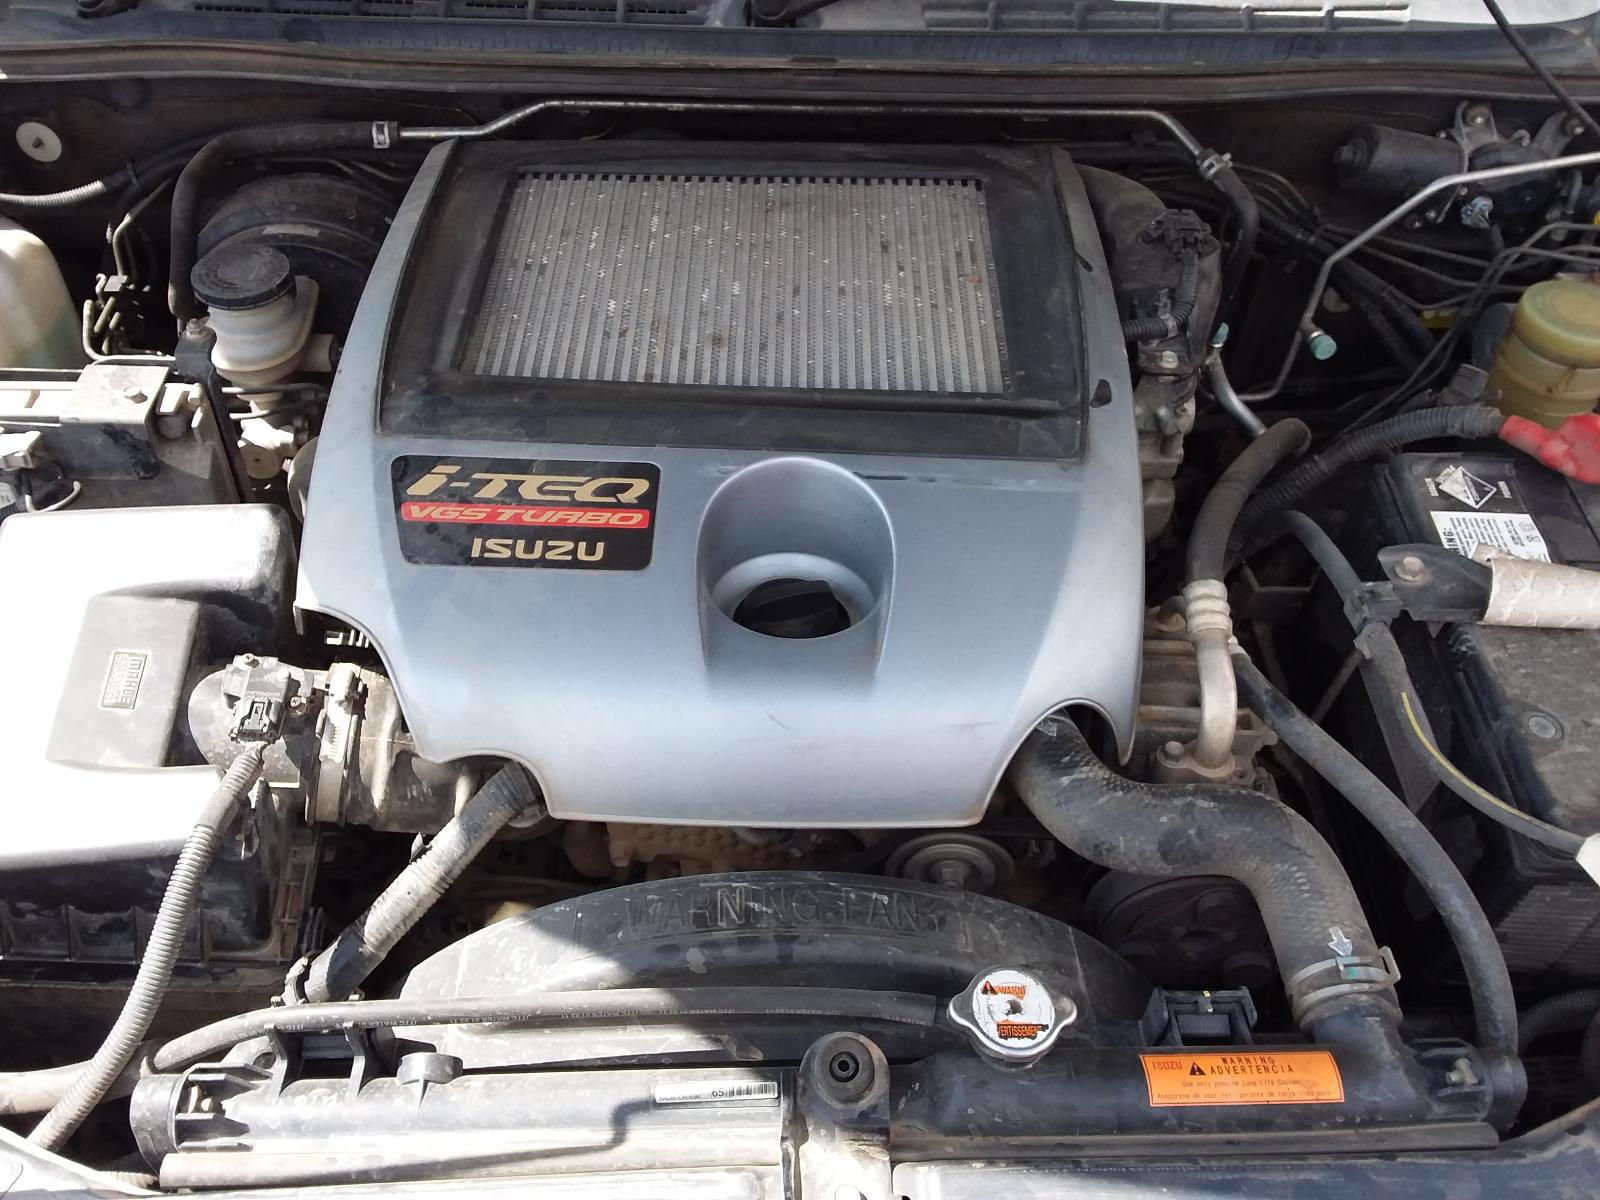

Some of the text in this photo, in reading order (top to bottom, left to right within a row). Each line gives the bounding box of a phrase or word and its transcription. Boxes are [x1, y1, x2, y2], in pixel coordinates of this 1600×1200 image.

[406, 465, 650, 503] i-TEQ
[409, 505, 643, 526] VGS TURBO
[471, 537, 605, 561] ISUZU
[1152, 1061, 1183, 1070] ISUZU
[1221, 1056, 1275, 1065] WARNING
[1210, 1064, 1294, 1075] ADVERTENCIA
